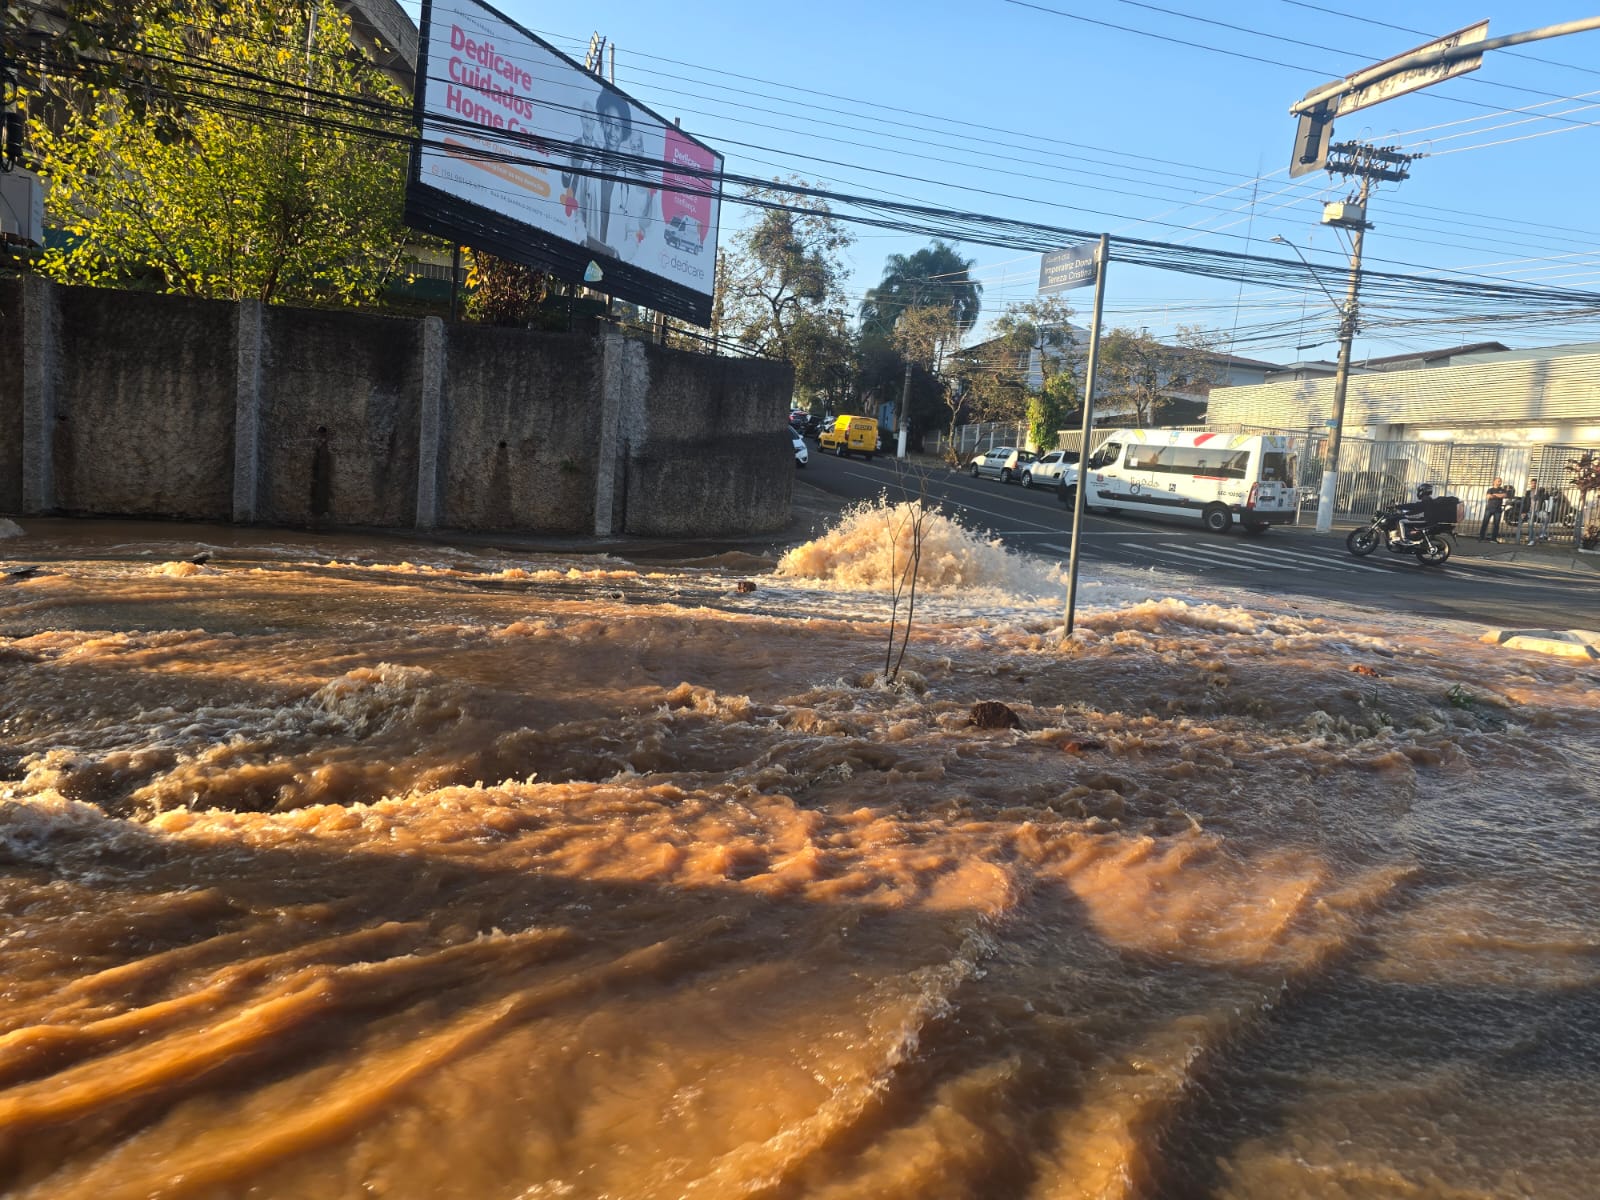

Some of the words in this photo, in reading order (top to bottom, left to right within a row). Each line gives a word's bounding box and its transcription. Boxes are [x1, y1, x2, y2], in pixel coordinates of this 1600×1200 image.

[451, 23, 532, 92] Dedicare
[449, 56, 533, 120] Cuidados
[446, 84, 504, 129] Home
[671, 255, 705, 280] dedicare
[1045, 262, 1074, 275] Imperatriz
[1075, 258, 1092, 268] Dona
[1068, 268, 1092, 281] Cristina
